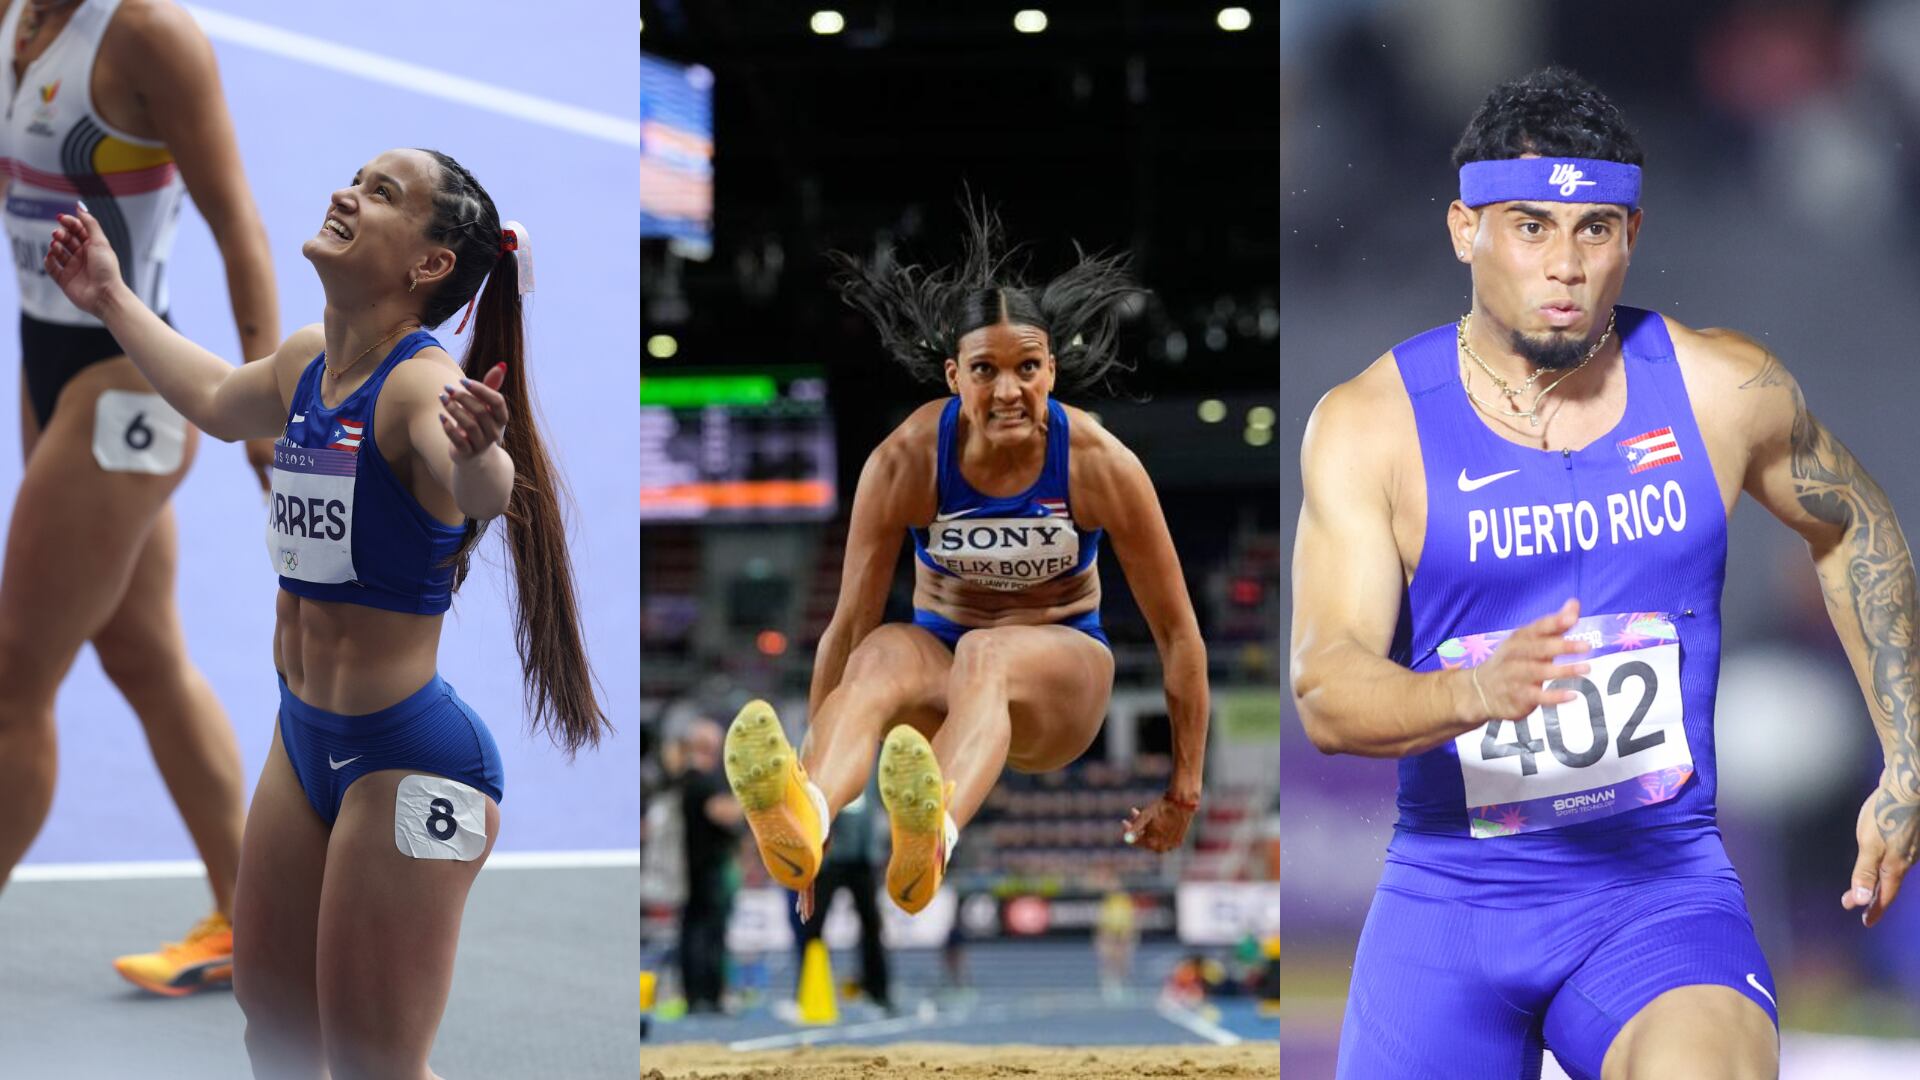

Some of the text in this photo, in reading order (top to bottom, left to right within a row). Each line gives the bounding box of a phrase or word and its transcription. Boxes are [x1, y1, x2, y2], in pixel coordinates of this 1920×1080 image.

[125, 411, 153, 451] 6
[285, 453, 314, 467] 2024
[270, 490, 346, 541] ORRES
[1468, 480, 1687, 562] PUERTO RICO
[941, 526, 1061, 550] SONY
[1000, 555, 1073, 577] BOYER
[1480, 660, 1666, 777] 402
[426, 797, 457, 841] 8
[1553, 788, 1615, 811] BORNAN
